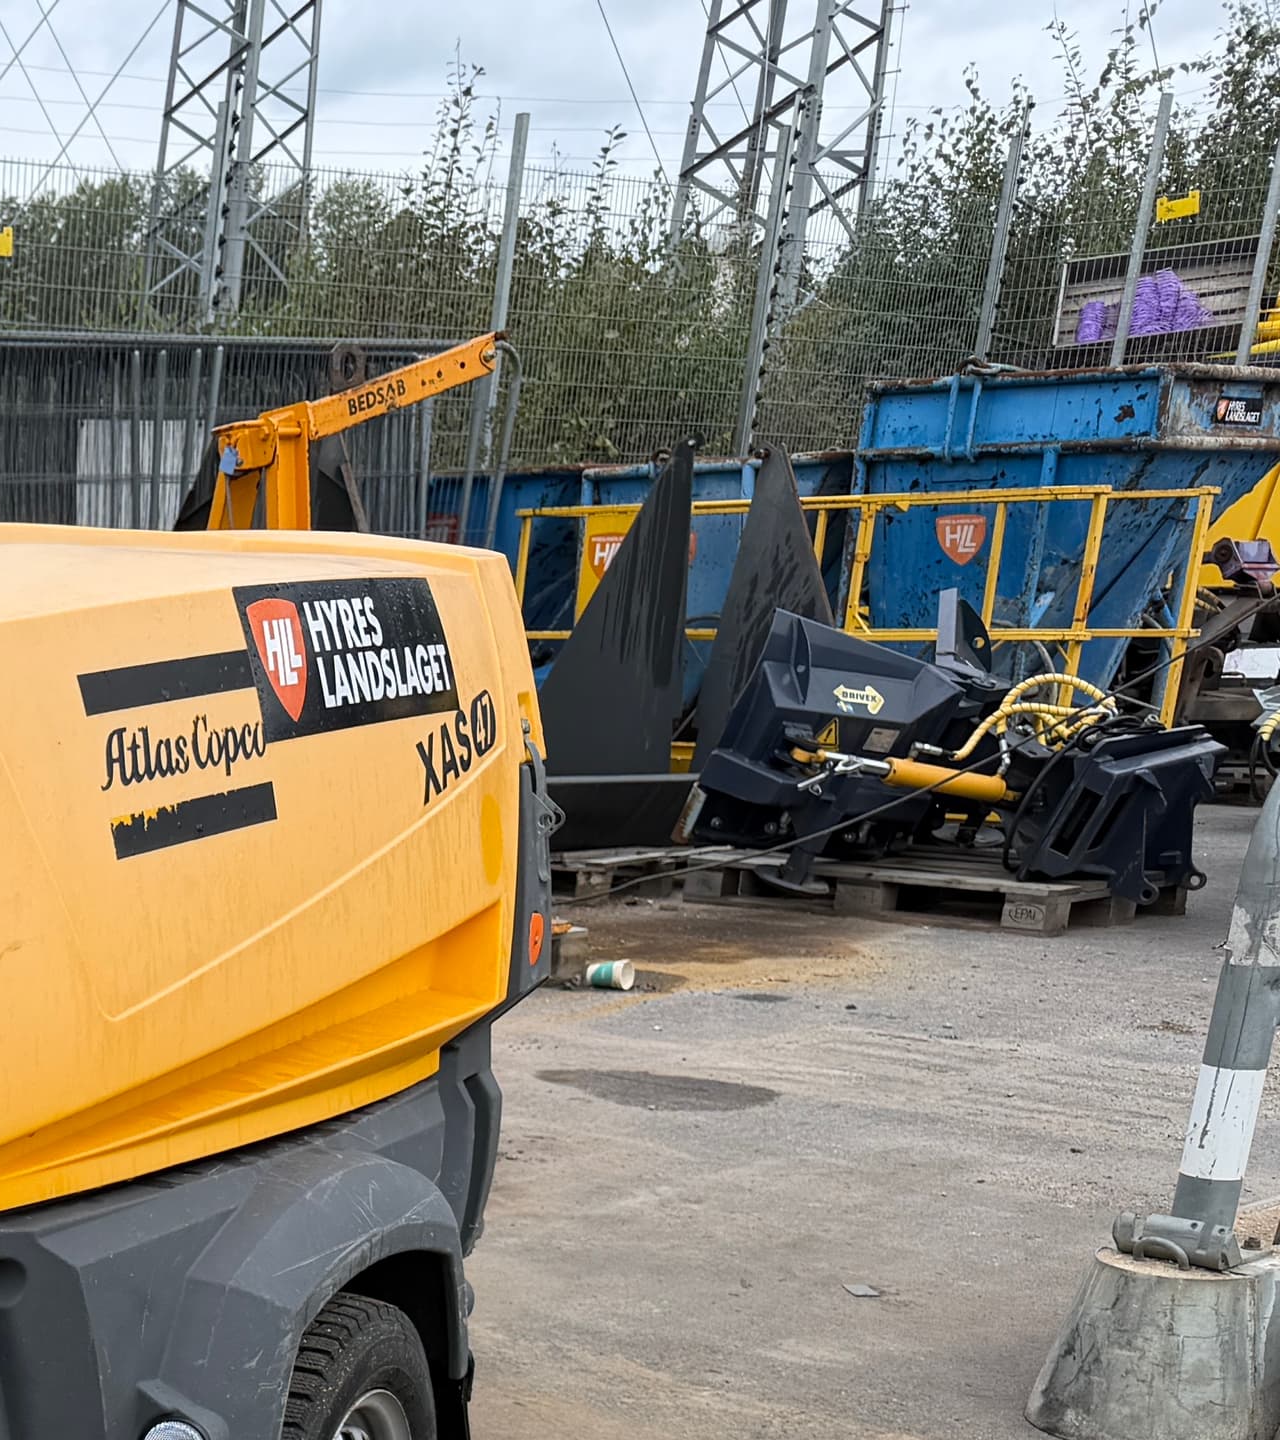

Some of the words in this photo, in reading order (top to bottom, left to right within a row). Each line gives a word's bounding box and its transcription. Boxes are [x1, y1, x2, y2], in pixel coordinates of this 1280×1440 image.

[302, 596, 383, 652] HYRES
[316, 643, 452, 709] LANDSLAGET
[101, 724, 189, 791] Atlas
[415, 709, 472, 806] XAS
